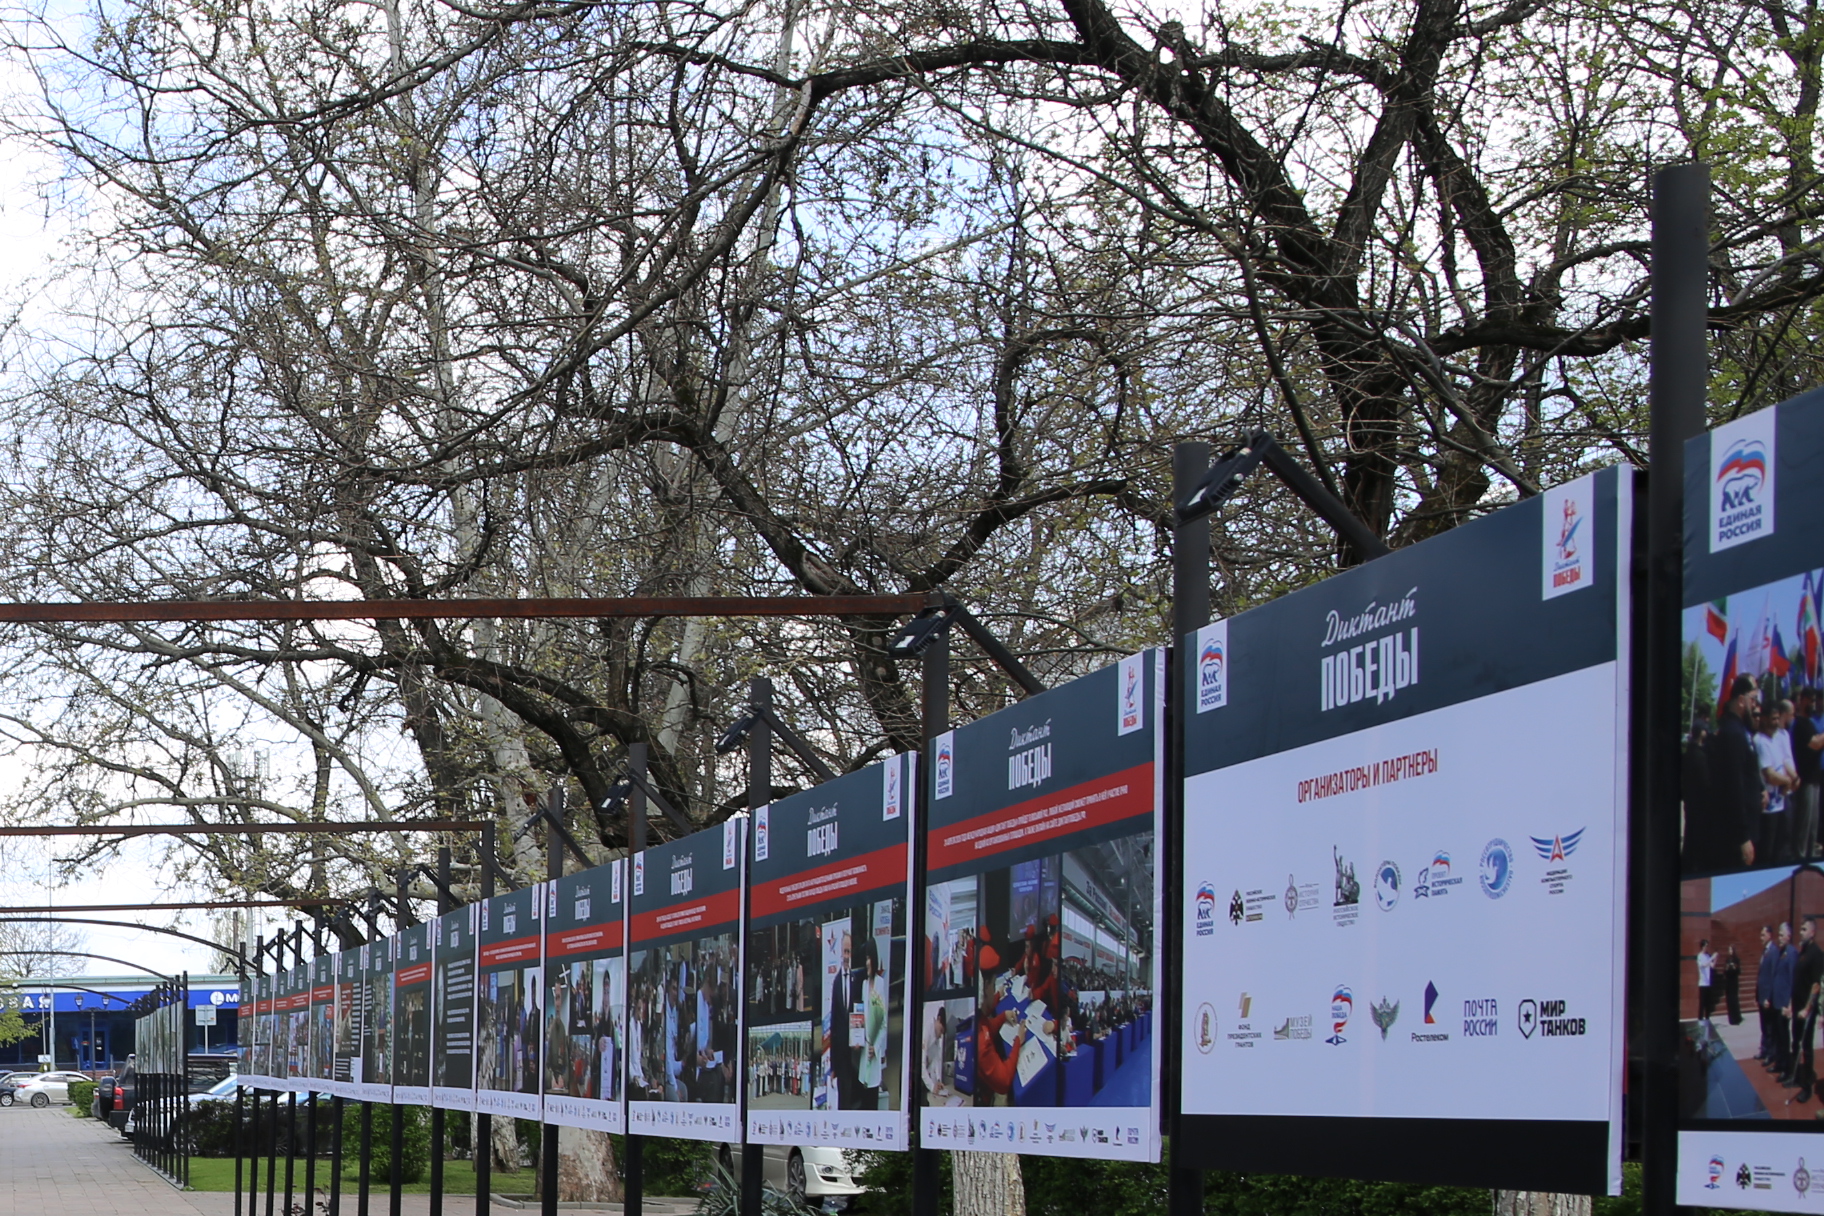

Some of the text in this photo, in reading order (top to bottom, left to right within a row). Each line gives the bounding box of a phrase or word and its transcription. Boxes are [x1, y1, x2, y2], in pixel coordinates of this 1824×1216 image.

[1719, 504, 1762, 528] ЕДИНАЯ
[1719, 518, 1762, 542] РОССИЯ
[1321, 586, 1418, 647] Диктант
[1321, 626, 1418, 711] ПОБЕДЫ
[1201, 693, 1222, 707] РОССИЯ
[1009, 718, 1052, 751] Диктант
[1008, 743, 1052, 790] ПОБЕДЫ
[1297, 748, 1438, 804] ОРГАНИЗАТОРЫ И ПАРТНЕРЫ
[1464, 999, 1498, 1017] ПОЧТА
[1540, 1000, 1566, 1017] МИР
[1290, 1014, 1313, 1028] МУЗЕЙ
[1464, 1018, 1498, 1036] РОССИИ
[1540, 1018, 1586, 1036] ТАНКОВ
[1290, 1028, 1313, 1040] ПОБЕДЫ
[1411, 1032, 1449, 1042] Ростелеком
